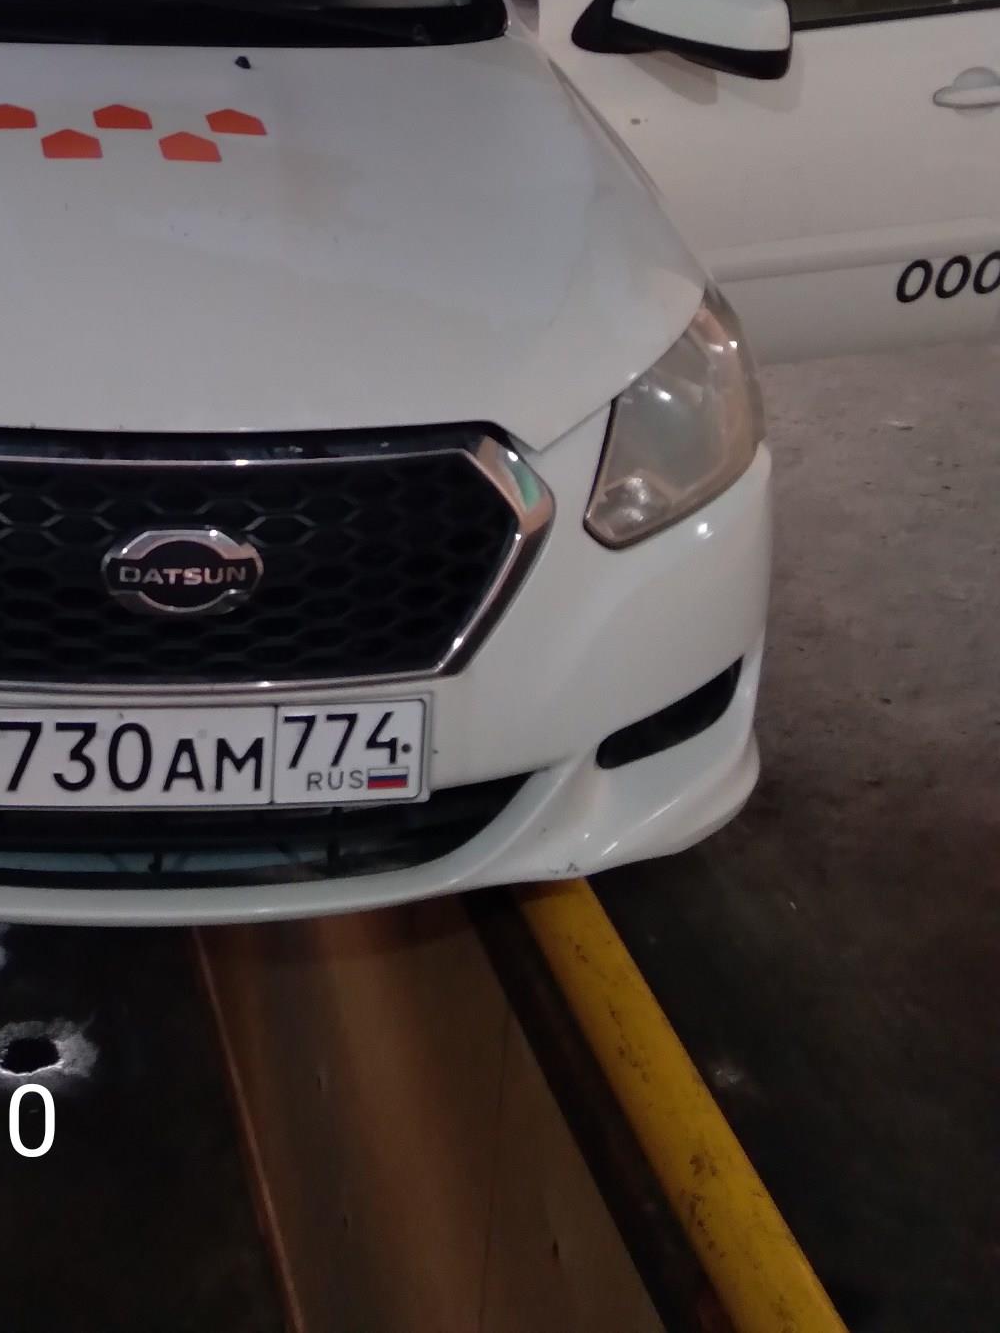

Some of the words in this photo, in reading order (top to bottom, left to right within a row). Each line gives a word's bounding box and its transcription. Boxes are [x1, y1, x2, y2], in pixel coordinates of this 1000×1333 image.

[119, 566, 246, 586] DATSUN
[283, 711, 399, 770] 774
[306, 769, 365, 792] RUS
